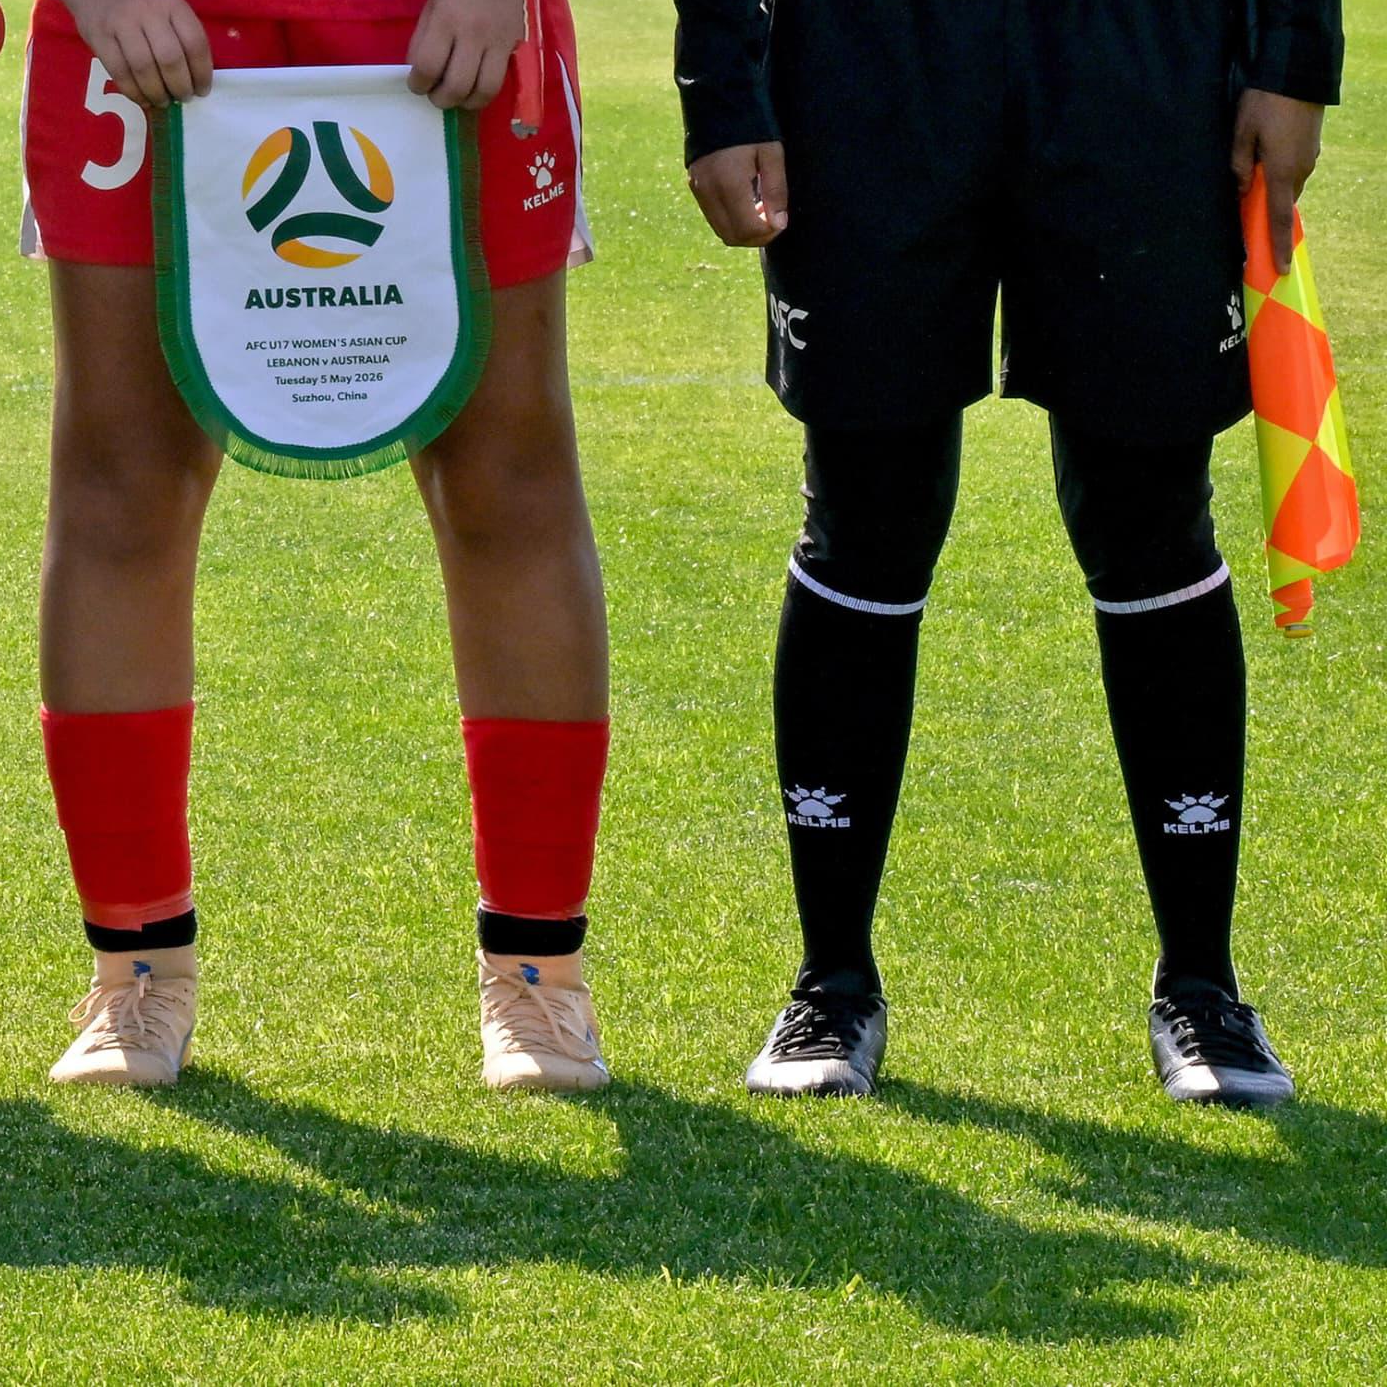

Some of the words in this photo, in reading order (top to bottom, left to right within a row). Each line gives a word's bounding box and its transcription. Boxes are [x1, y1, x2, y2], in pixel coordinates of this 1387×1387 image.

[80, 57, 148, 191] 5
[523, 181, 565, 211] KELME
[244, 284, 404, 310] AUSTRALIA
[245, 341, 267, 351] AFC
[269, 340, 289, 350] U17
[348, 337, 383, 347] ASIAN
[384, 336, 408, 346] CUP
[266, 357, 320, 368] LEBANON
[321, 358, 328, 366] v
[330, 355, 390, 365] AUSTRALIA
[274, 375, 319, 387] Tuesday
[320, 374, 328, 384] 5
[329, 374, 353, 385] May
[355, 372, 384, 383] 2026
[292, 392, 335, 403] Suzhou,
[337, 391, 368, 402] China
[787, 813, 851, 829] KELME
[1163, 820, 1230, 834] KELME
